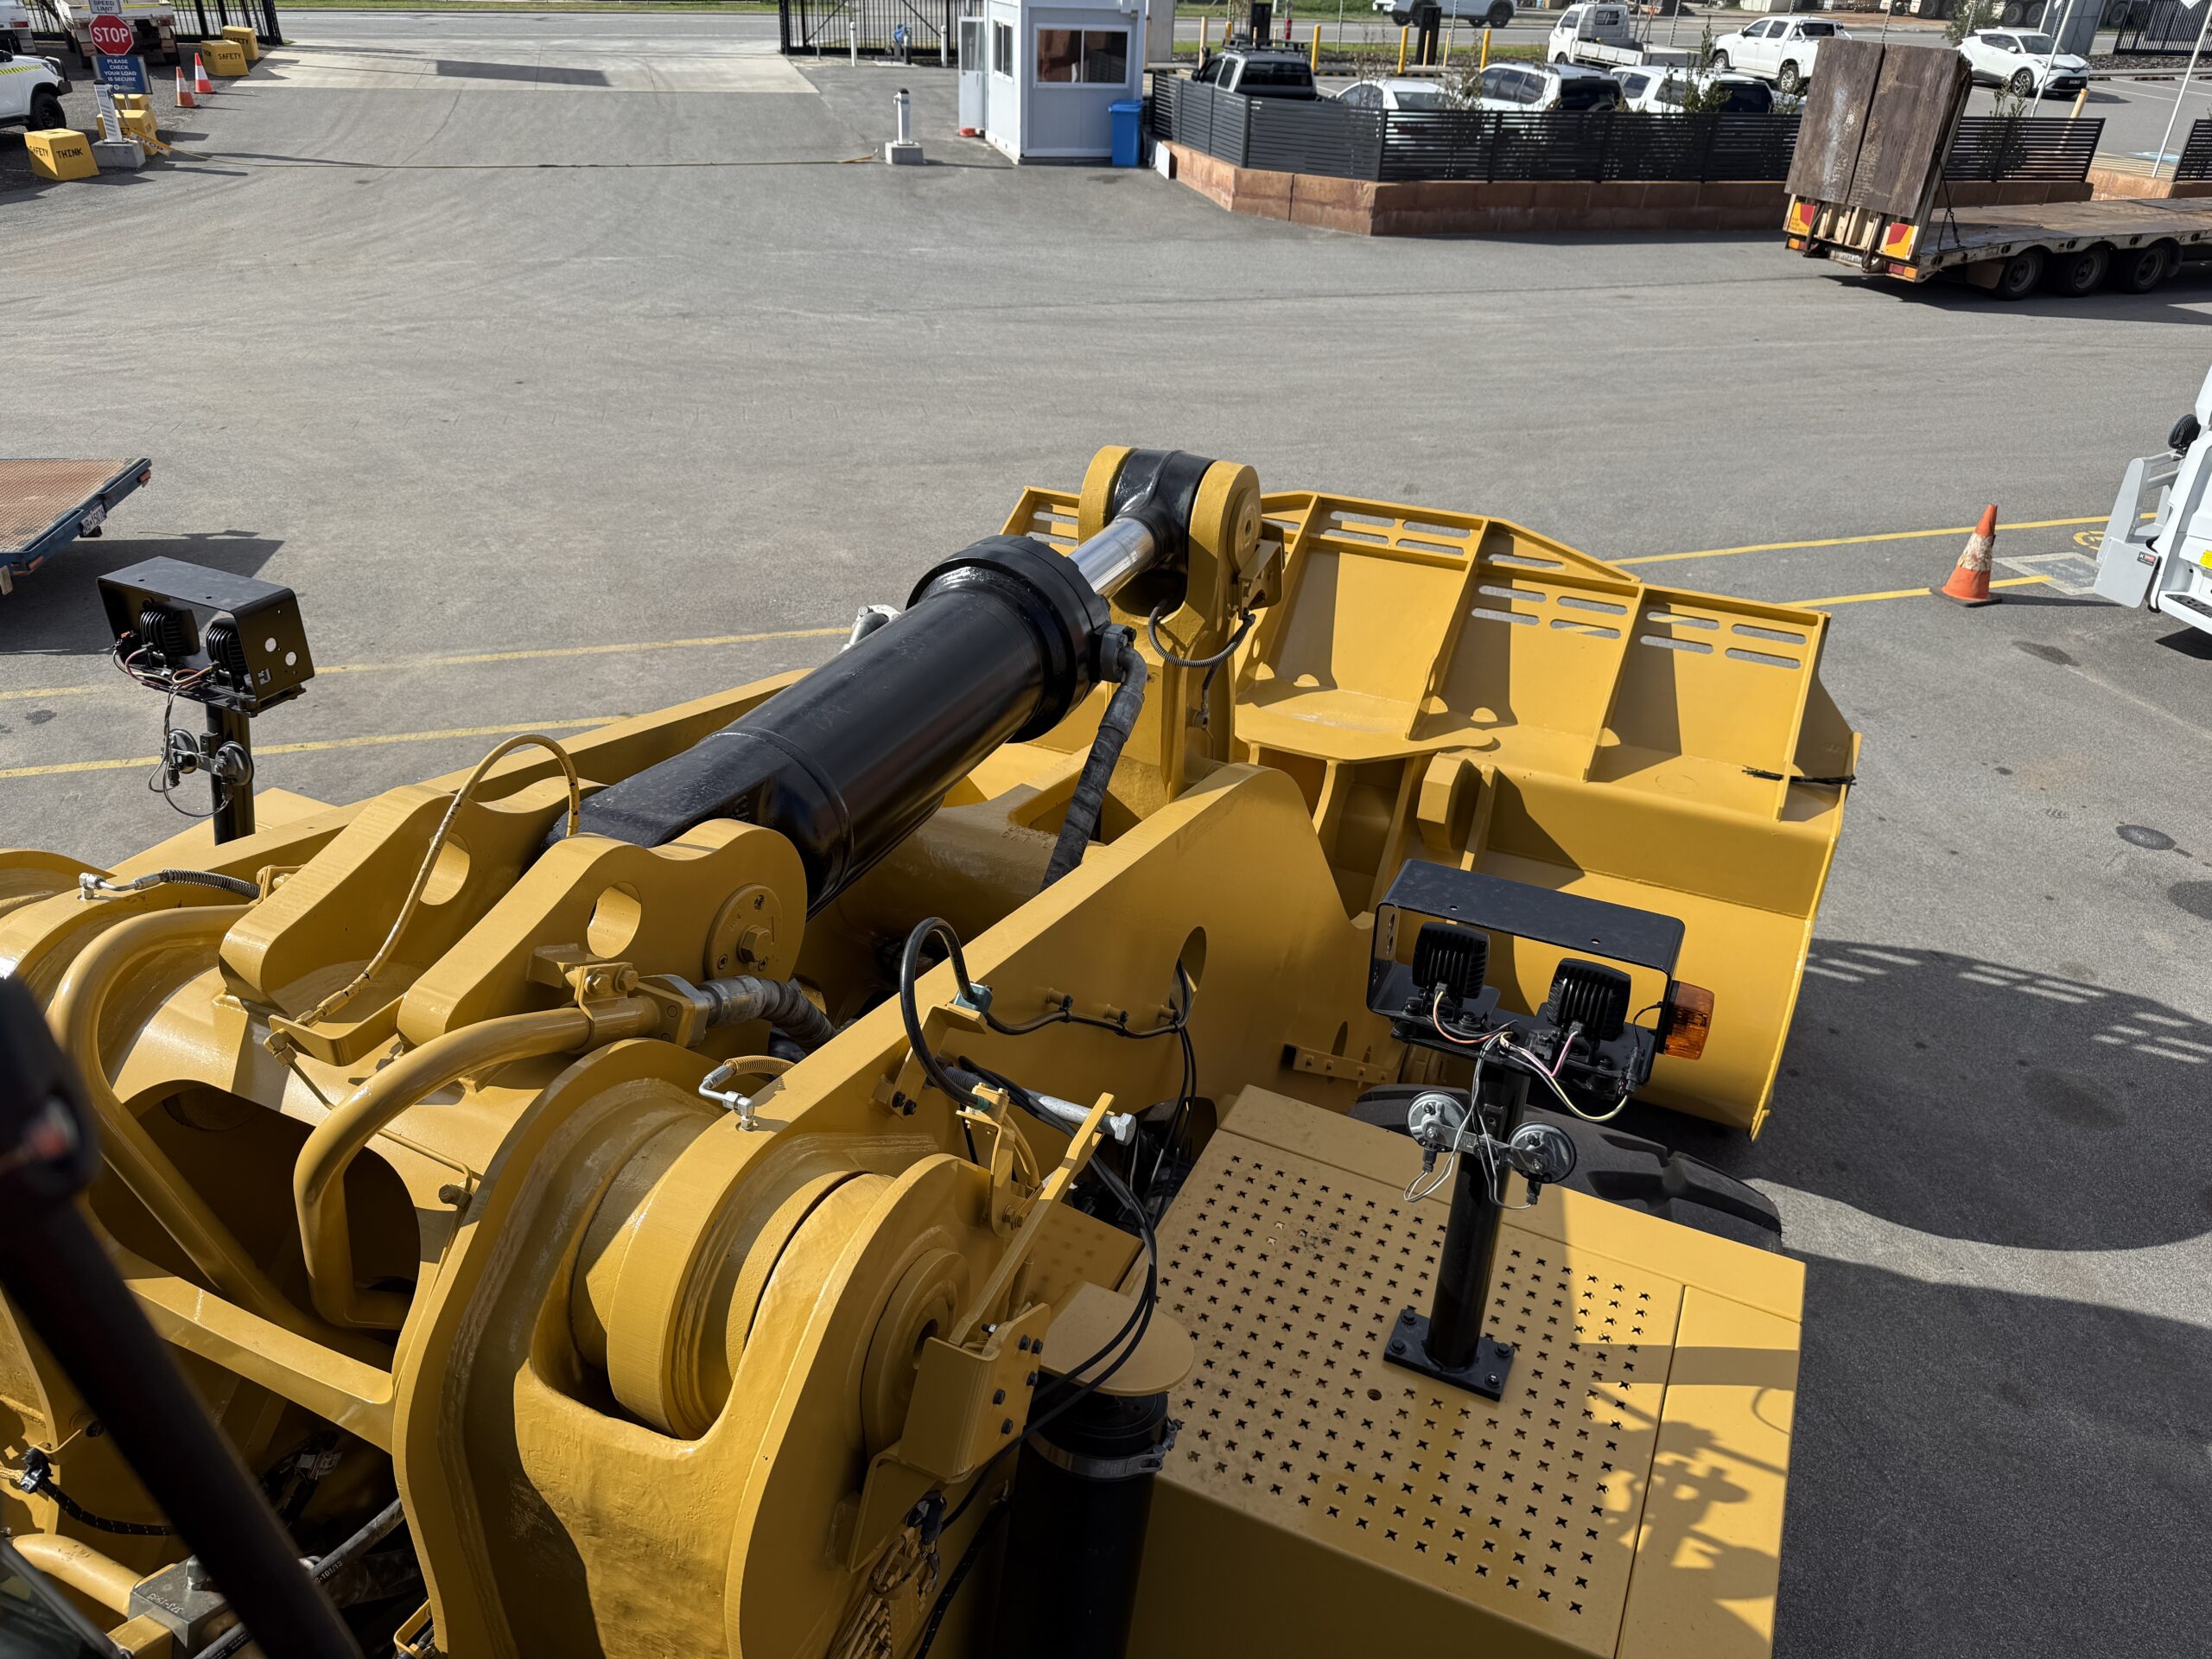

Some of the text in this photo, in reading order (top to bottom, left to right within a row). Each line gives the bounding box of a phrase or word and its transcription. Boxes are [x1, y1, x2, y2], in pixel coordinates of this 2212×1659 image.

[93, 27, 129, 43] STOP
[137, 135, 163, 151] STOP
[29, 145, 83, 159] SAFETY THINK
